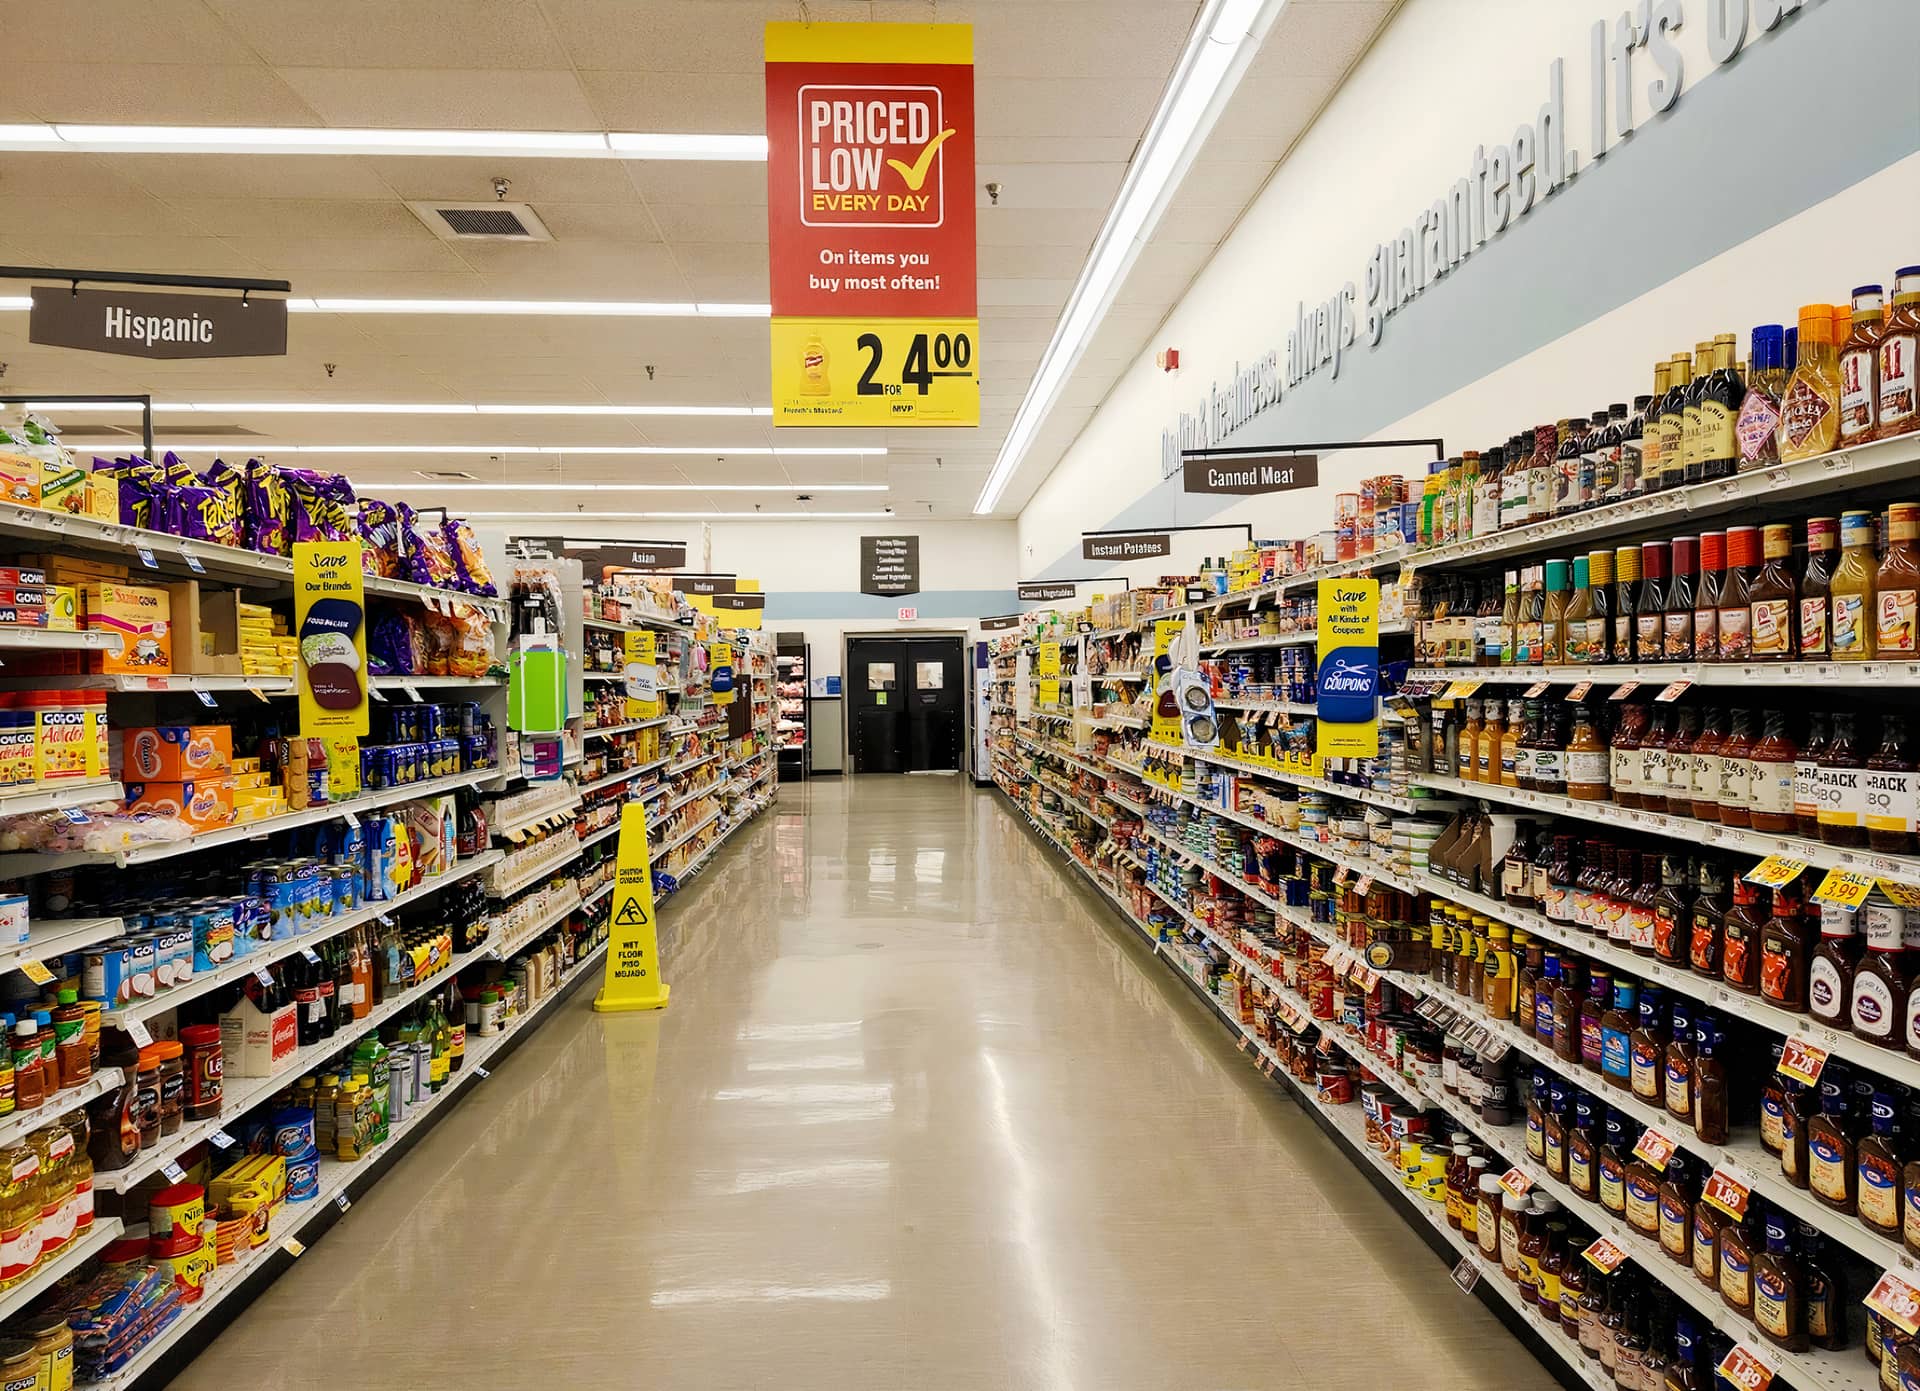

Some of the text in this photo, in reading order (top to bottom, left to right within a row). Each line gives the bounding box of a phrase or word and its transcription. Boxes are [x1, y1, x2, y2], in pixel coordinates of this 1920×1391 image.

[811, 101, 930, 144] PRICED
[811, 147, 883, 191] LOW
[812, 194, 929, 212] EVERY DAY
[819, 249, 929, 268] On items you
[809, 274, 940, 292] buy most often!
[105, 306, 214, 347] Hispanic
[1288, 281, 1356, 388] always
[884, 385, 901, 395] FOR
[892, 405, 914, 413] MVP
[1208, 466, 1295, 487] Canned Meat
[1091, 541, 1162, 556] Instant Potatoes
[309, 553, 348, 568] Save
[631, 551, 656, 564] Asian
[318, 570, 339, 579] with
[305, 581, 353, 591] Our Brands
[1333, 588, 1368, 603] Save
[900, 608, 916, 619] EXIT
[1340, 605, 1358, 613] with
[1327, 614, 1370, 624] All Kinds of
[1332, 625, 1366, 635] Coupons
[1324, 676, 1372, 692] COUPONS
[1823, 772, 1858, 788] RACK
[1872, 776, 1908, 793] RACK
[619, 868, 643, 876] CAUTION
[619, 876, 645, 885] CUIDADO
[1824, 881, 1860, 900] 3.99
[622, 941, 639, 949] WET
[618, 950, 643, 959] FLOOR
[621, 960, 640, 968] PISO
[614, 969, 647, 979] MOJADO
[1788, 1050, 1815, 1075] 2.28
[1714, 1183, 1741, 1208] 1.89
[1594, 1250, 1615, 1265] 1.89
[1883, 1288, 1919, 1318] 1.89
[1731, 1358, 1762, 1387] 1.89
